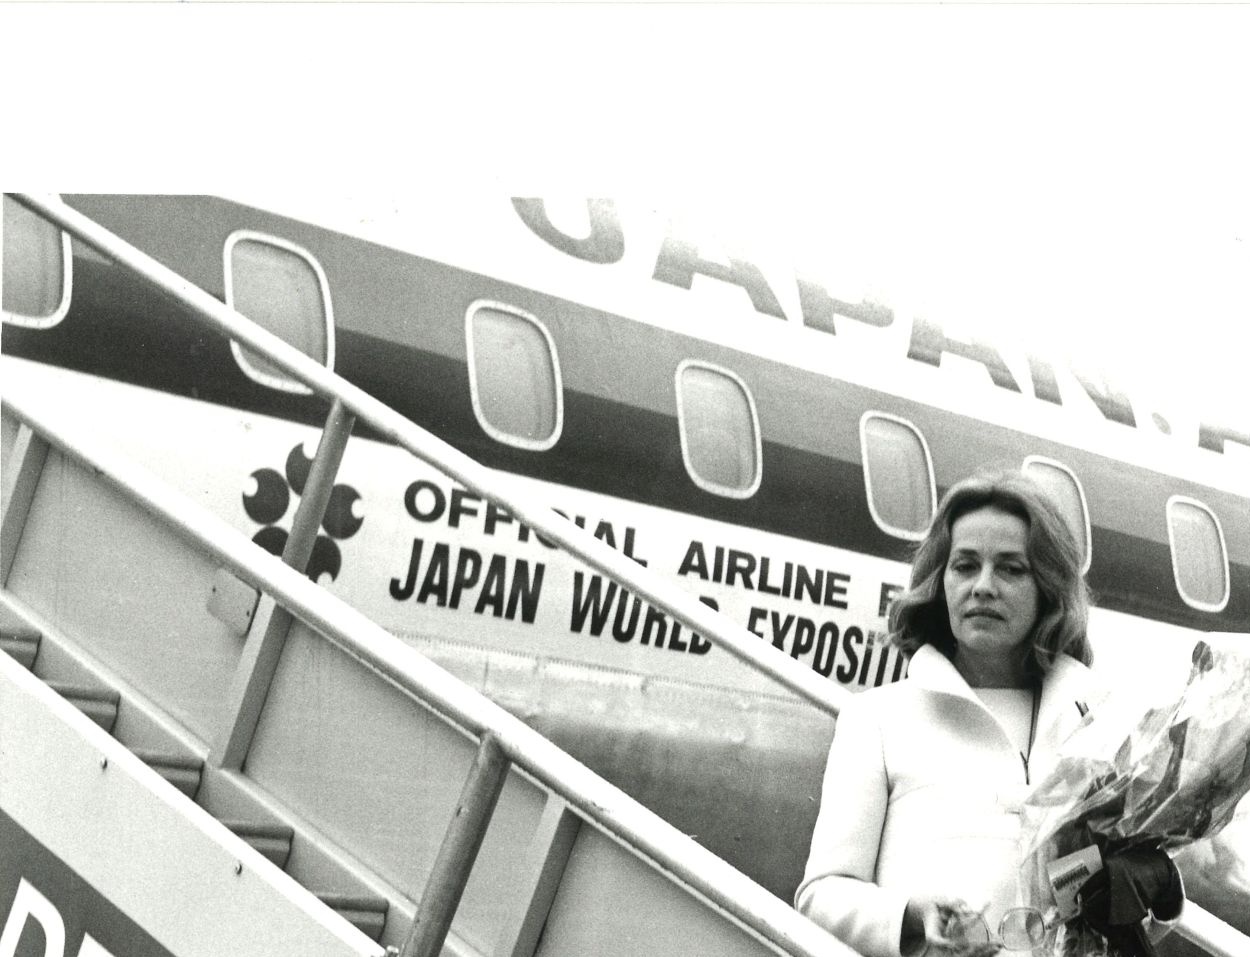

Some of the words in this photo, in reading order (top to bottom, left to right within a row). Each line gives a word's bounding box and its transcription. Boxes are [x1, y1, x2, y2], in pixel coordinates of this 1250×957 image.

[389, 538, 546, 624] JAPAN
[404, 480, 648, 568] OFFAL
[677, 541, 850, 610] AIRLINE
